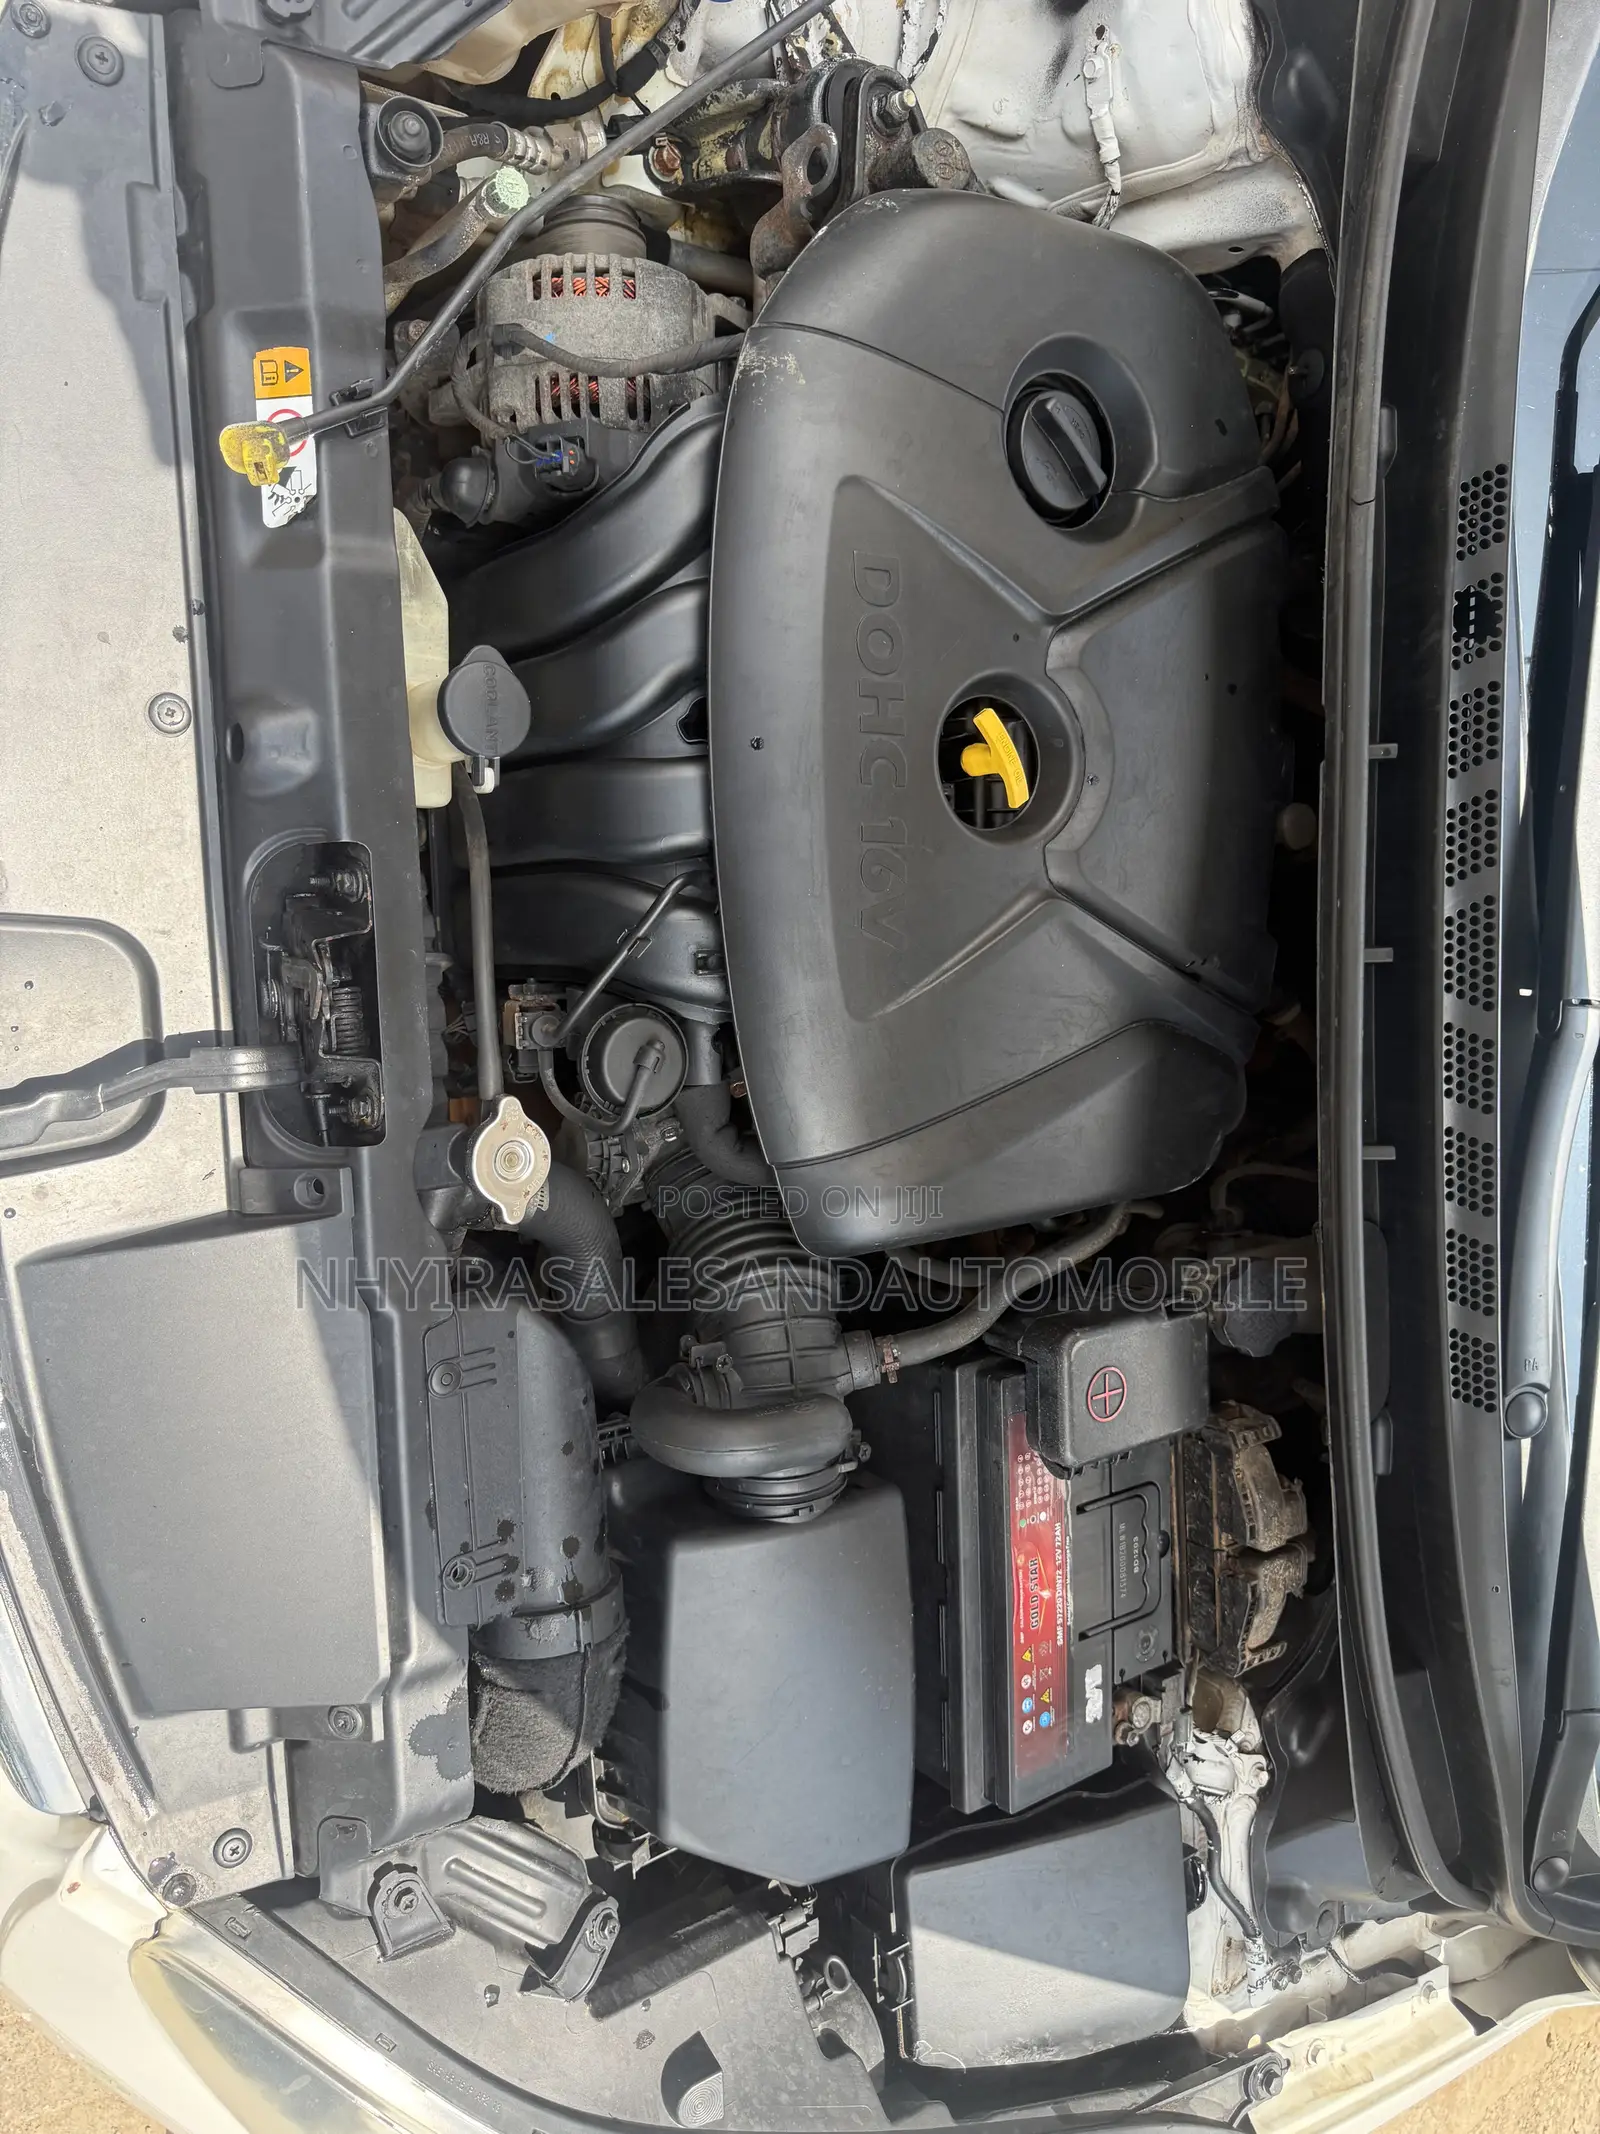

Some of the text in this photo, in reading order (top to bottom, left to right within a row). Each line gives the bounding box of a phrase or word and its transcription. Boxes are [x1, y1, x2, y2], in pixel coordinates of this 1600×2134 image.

[483, 664, 499, 754] COOLANT
[853, 550, 907, 951] DOHC 16V
[998, 733, 1024, 786] ENGINE OIL
[1029, 1557, 1039, 1629] GOLD STAR
[1055, 1598, 1064, 1625] 57220
[1056, 1626, 1064, 1647] SMF
